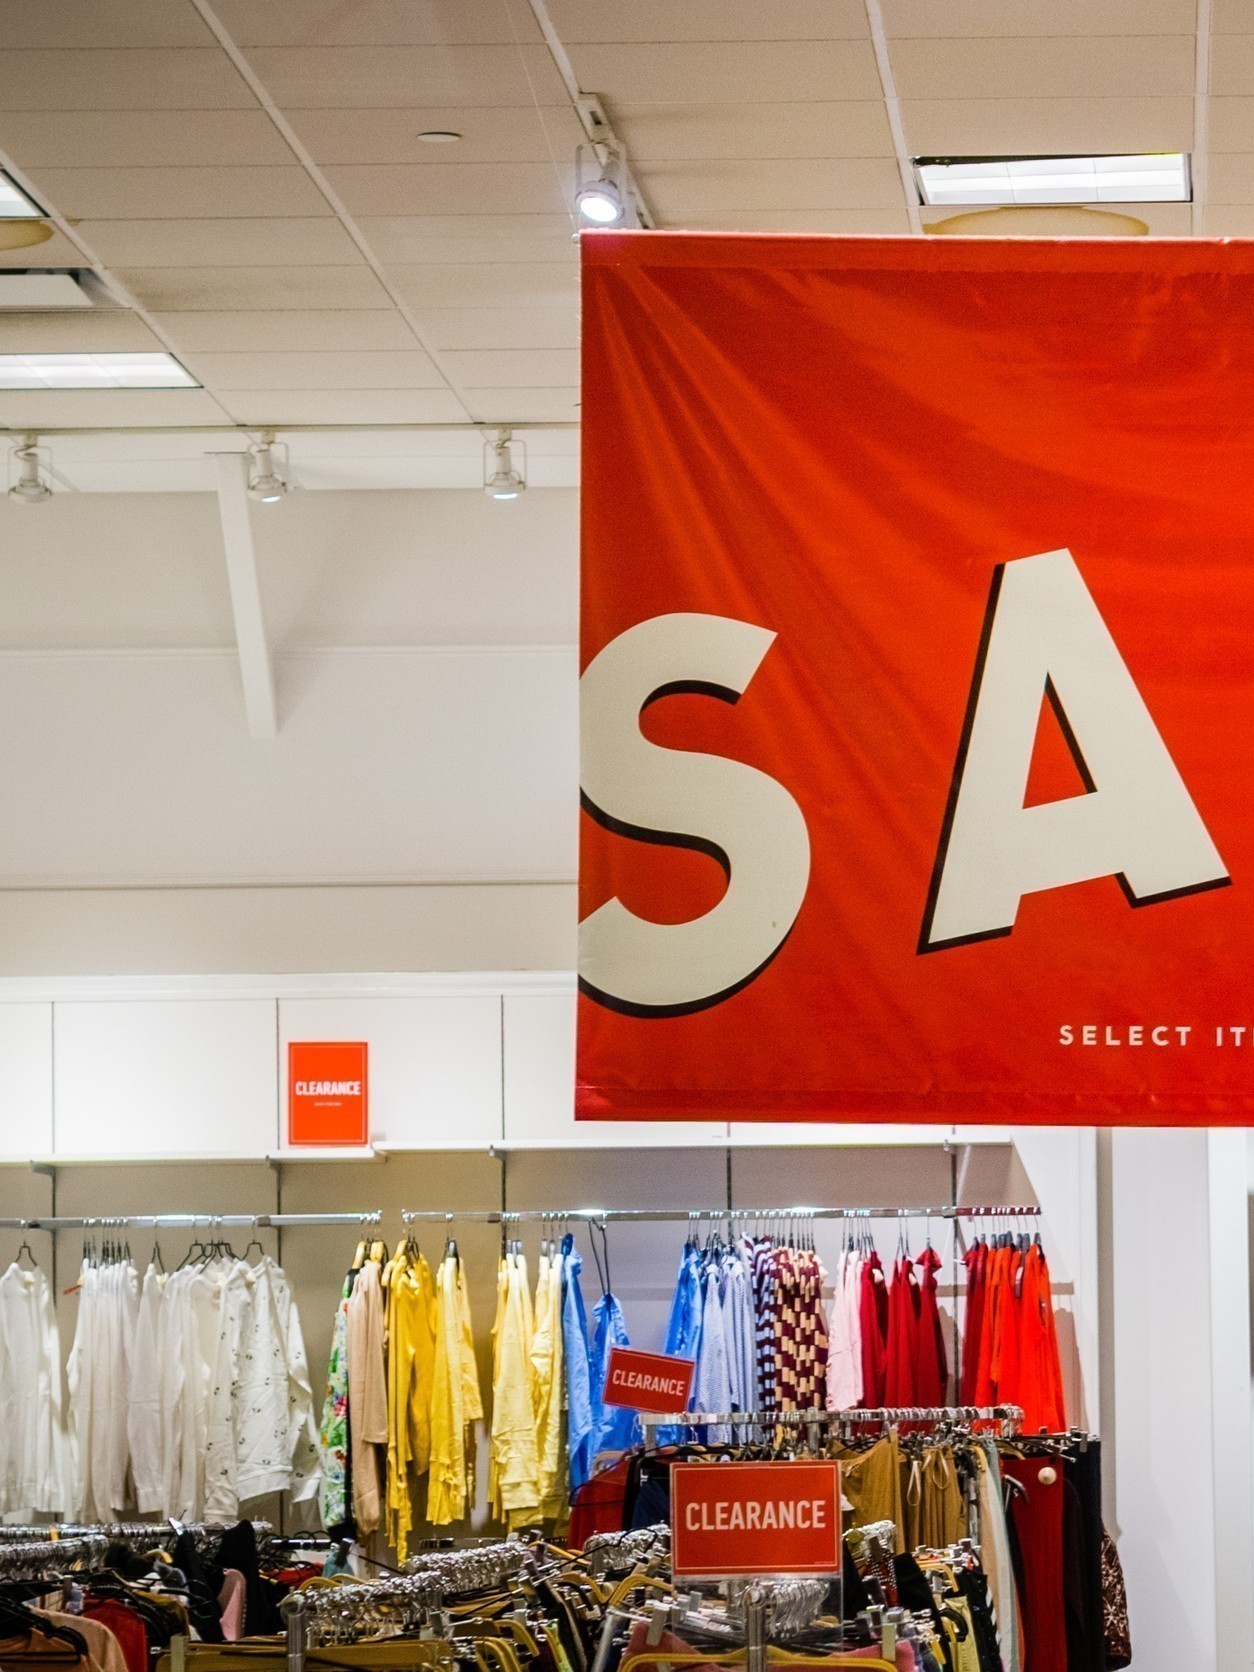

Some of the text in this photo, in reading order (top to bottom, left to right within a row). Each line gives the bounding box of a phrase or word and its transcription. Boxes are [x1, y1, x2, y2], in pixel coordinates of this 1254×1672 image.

[1058, 1024, 1192, 1048] SELECT
[295, 1081, 361, 1095] CLEARANCE
[612, 1369, 685, 1396] CLEARANCE
[685, 1500, 826, 1531] CLEARANCE
